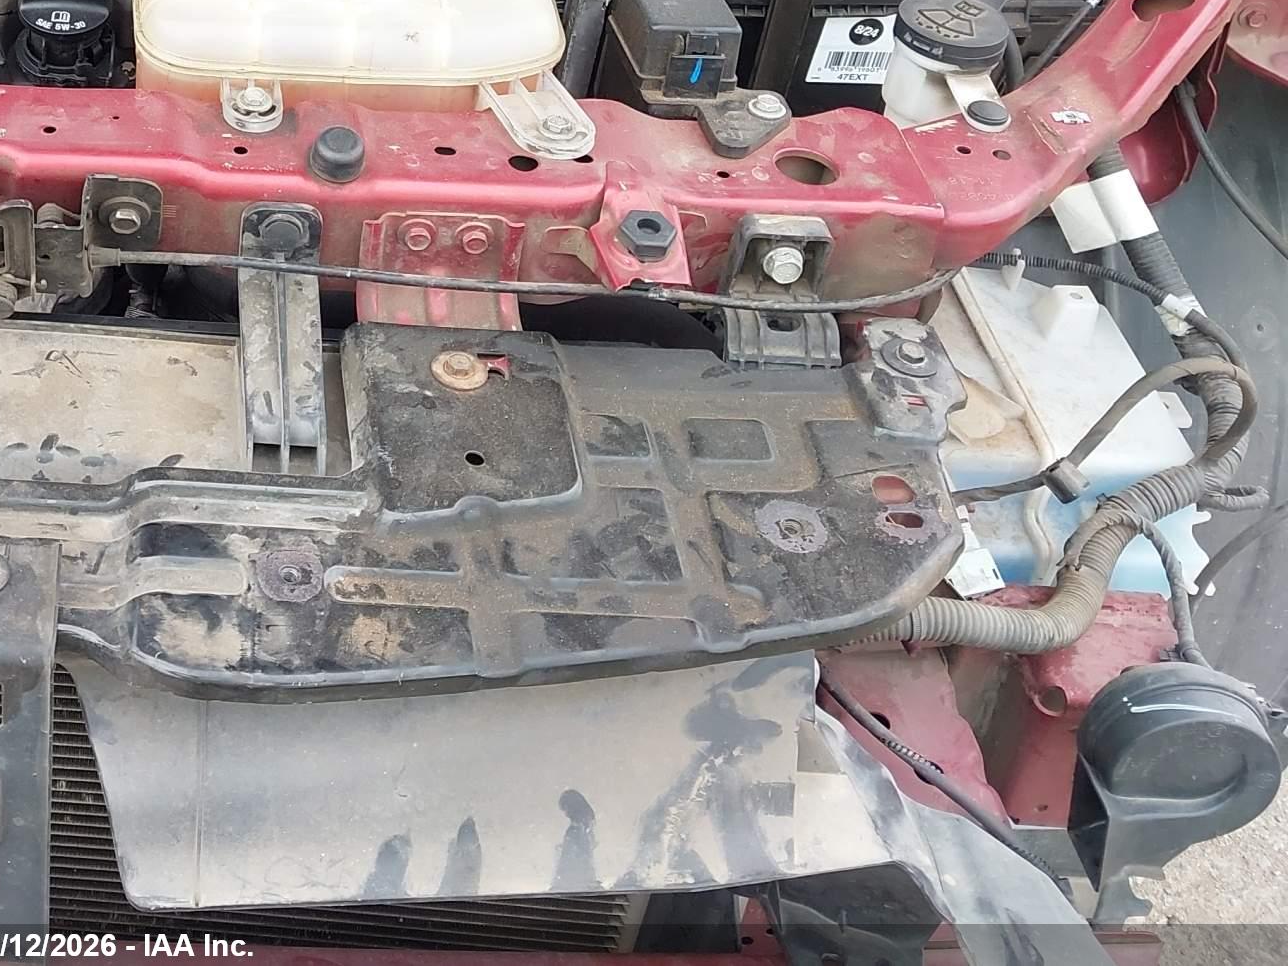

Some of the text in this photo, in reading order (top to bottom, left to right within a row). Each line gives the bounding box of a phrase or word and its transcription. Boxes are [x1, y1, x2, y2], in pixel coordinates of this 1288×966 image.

[35, 18, 86, 31] SAE 5W-30
[854, 25, 880, 38] 8/24
